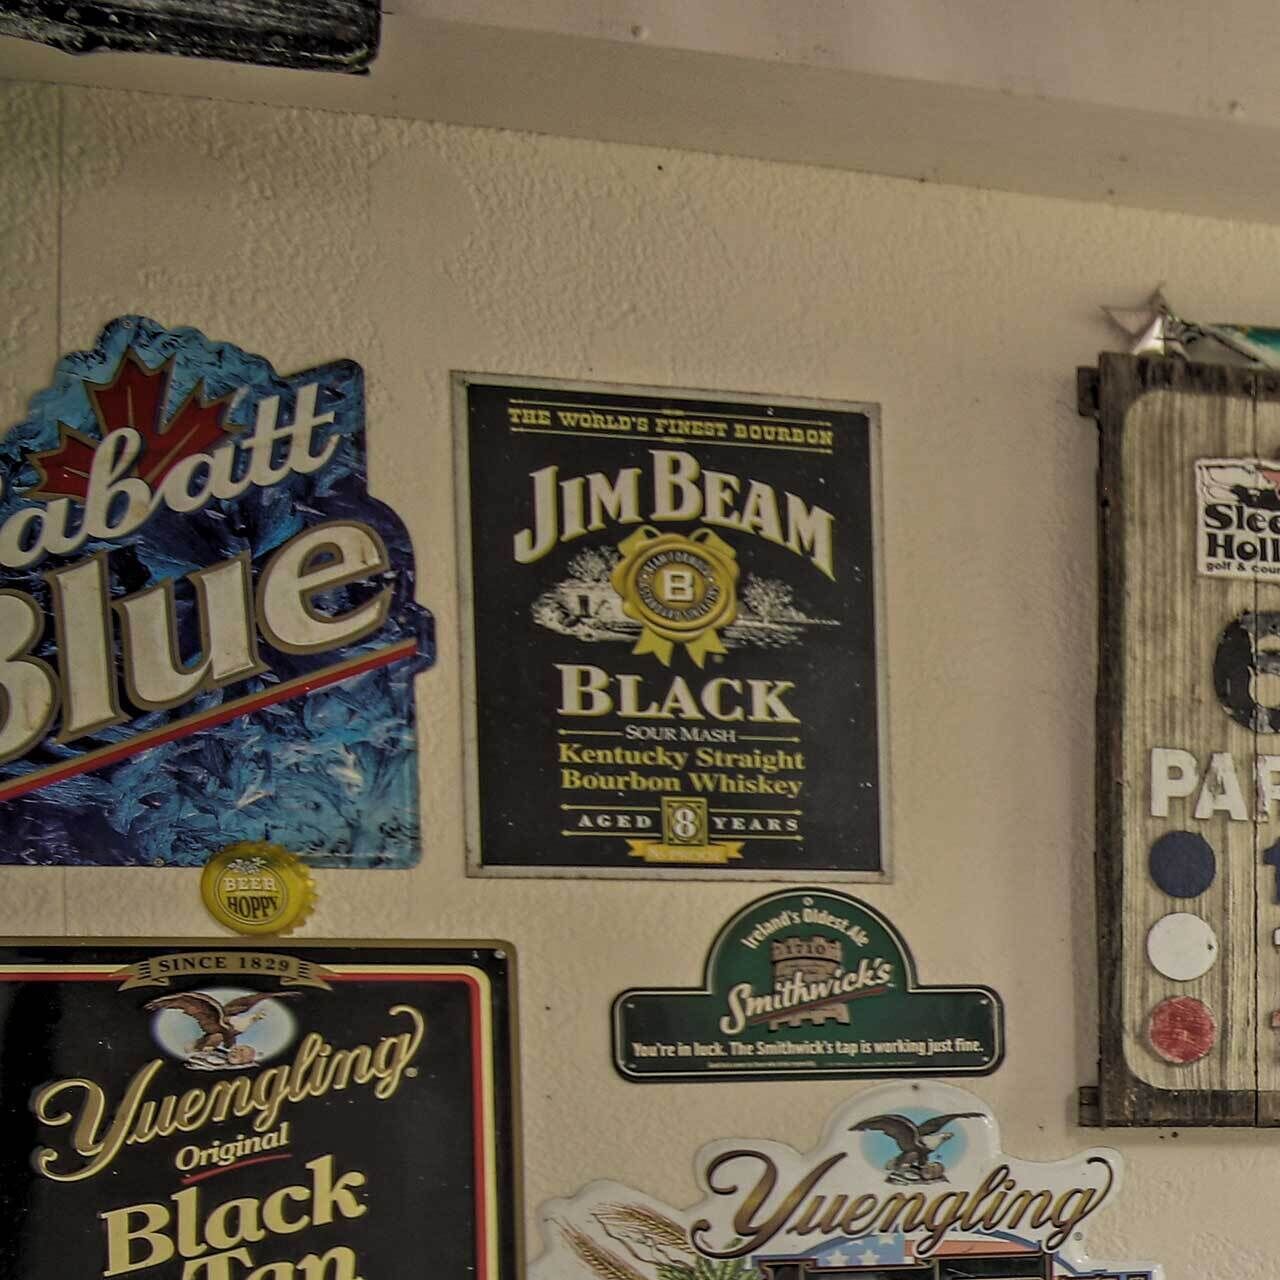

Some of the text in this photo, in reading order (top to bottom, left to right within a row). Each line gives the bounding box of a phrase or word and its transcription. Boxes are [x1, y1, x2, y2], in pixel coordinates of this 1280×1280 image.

[508, 408, 834, 446] THE WORLD'S FINEST BOURBON
[0, 383, 339, 568] abatt
[513, 449, 836, 581] JIM BEAM
[1206, 562, 1232, 573] golf
[1237, 563, 1246, 572] &
[663, 570, 694, 601] B
[553, 664, 800, 722] BLACK
[625, 724, 736, 743] SOUR MASH
[558, 743, 805, 773] Kentucky Straight
[561, 768, 803, 798] Bourbon Whiskey
[577, 807, 799, 839] AGED 8 YEARS
[224, 877, 277, 891] BEER
[227, 896, 280, 918] HOPPY
[740, 908, 870, 949] Ireland's Oldest Ale
[158, 956, 290, 972] SINCE 1829
[719, 957, 894, 1035] Smithwick's
[632, 1038, 984, 1057] You're in luck. The Smithwick's tap is working just fine.
[33, 1005, 425, 1181] Yuengling
[175, 1121, 291, 1171] Original
[100, 1154, 367, 1277] Black
[689, 1149, 1115, 1260] Yuengling
